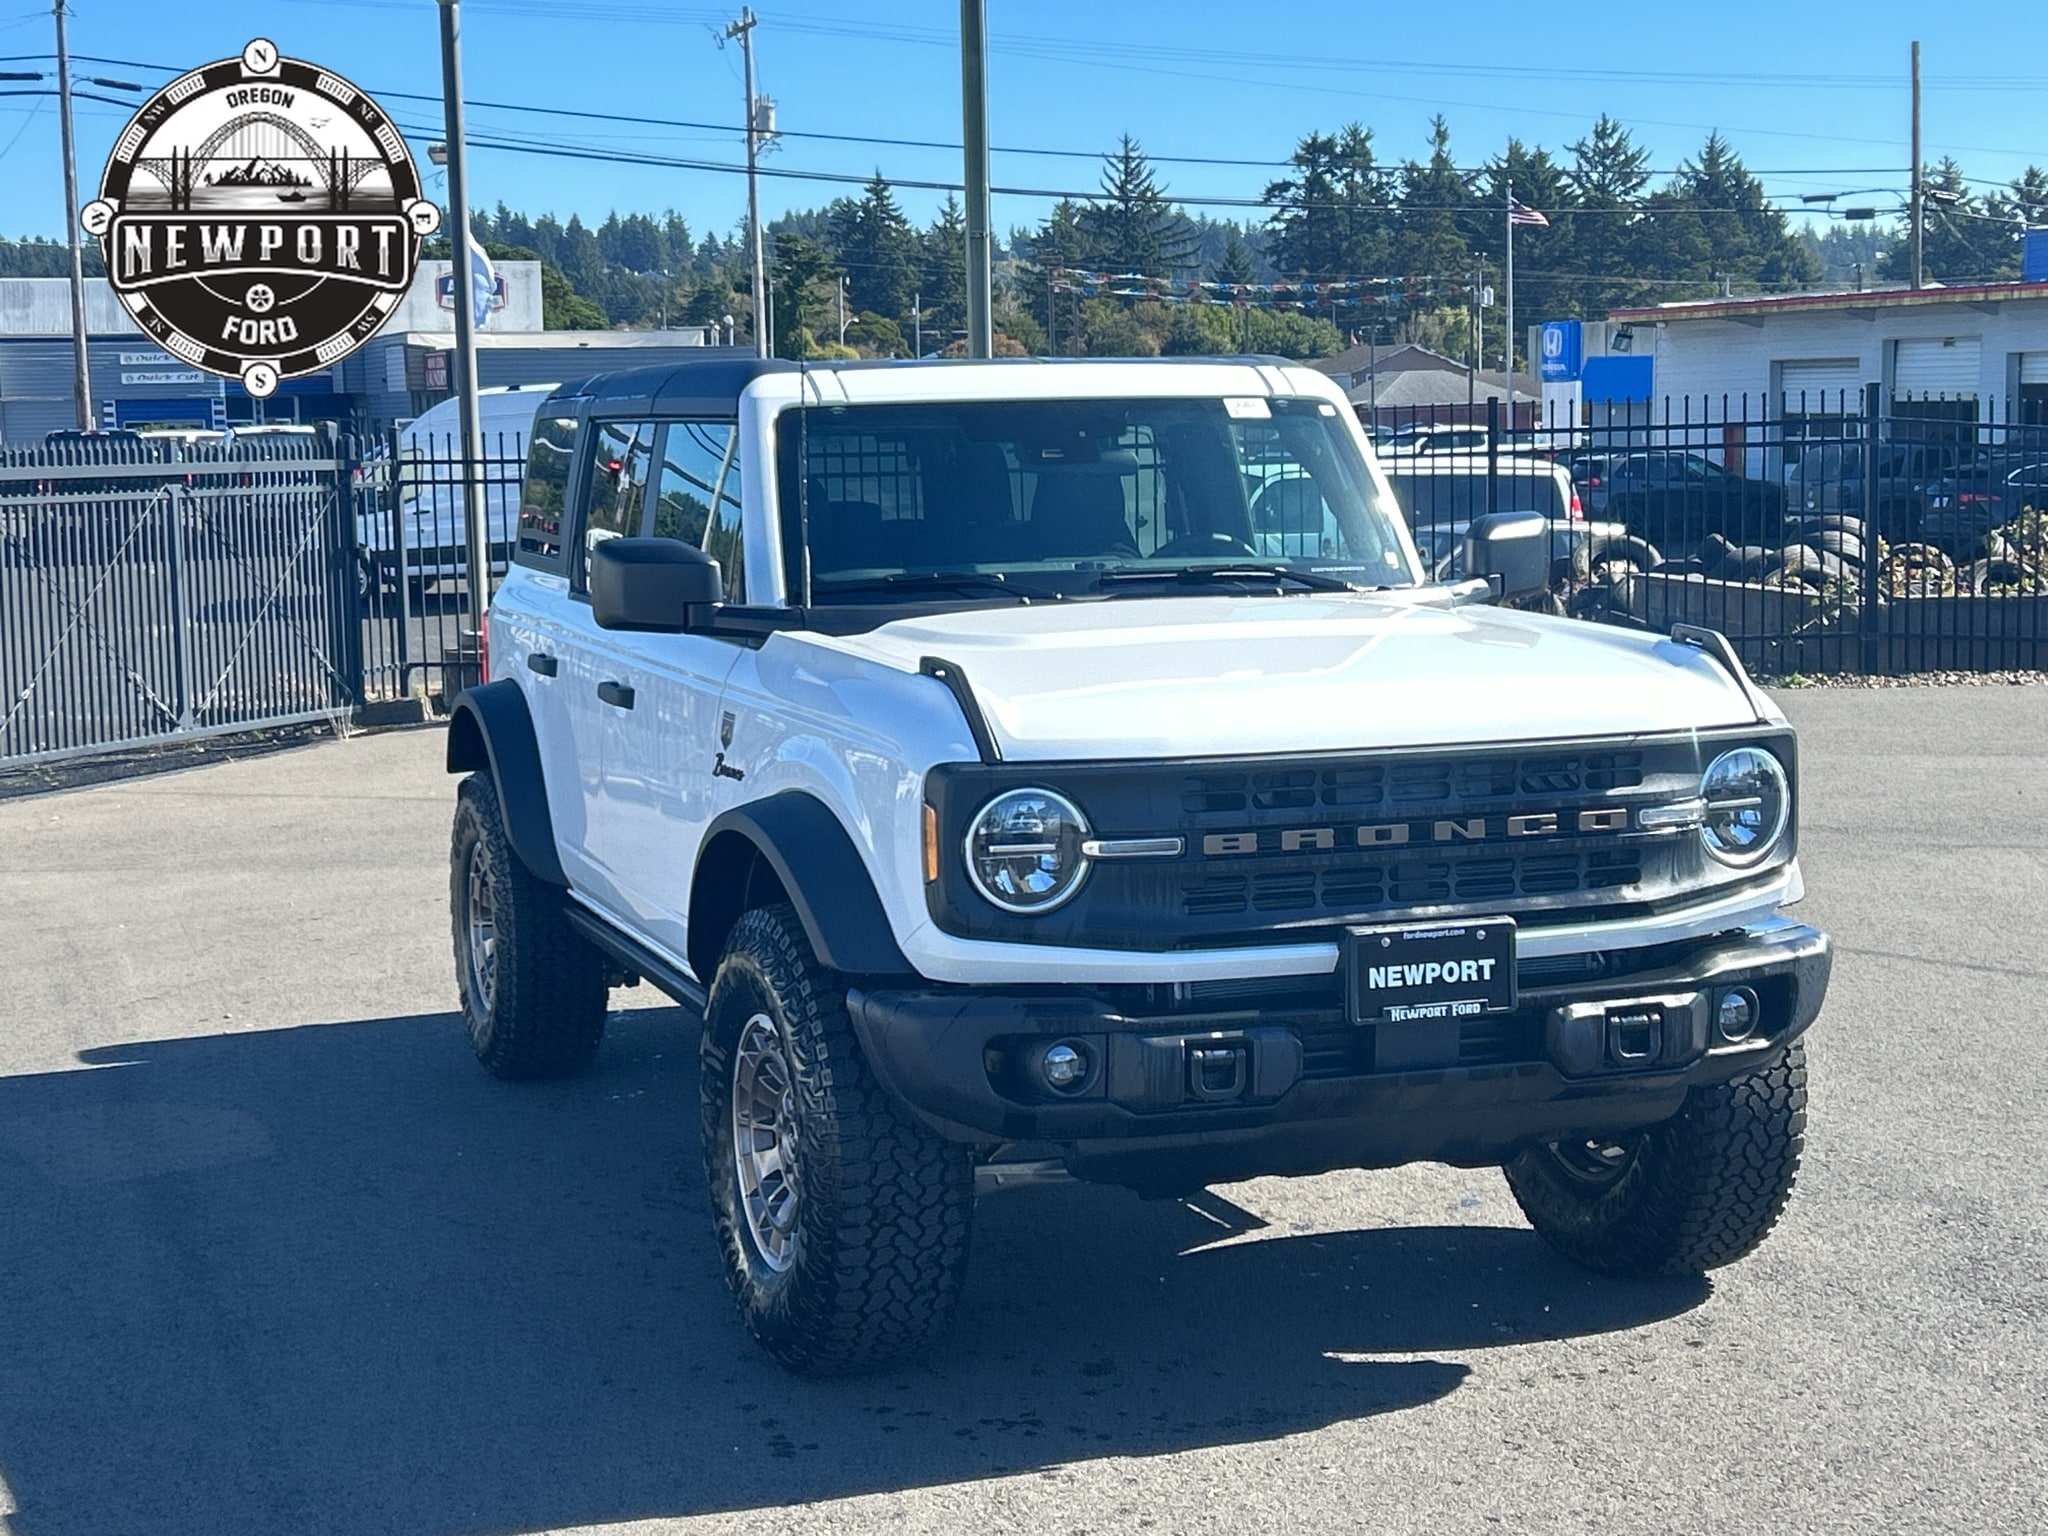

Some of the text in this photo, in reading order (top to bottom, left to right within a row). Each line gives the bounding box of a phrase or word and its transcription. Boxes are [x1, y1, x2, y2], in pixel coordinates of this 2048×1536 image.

[1203, 807, 1628, 856] BRONCO
[1403, 928, 1465, 939] fordnewport.com
[1368, 958, 1496, 990] NEWPORT
[1452, 1002, 1481, 1017] FORD
